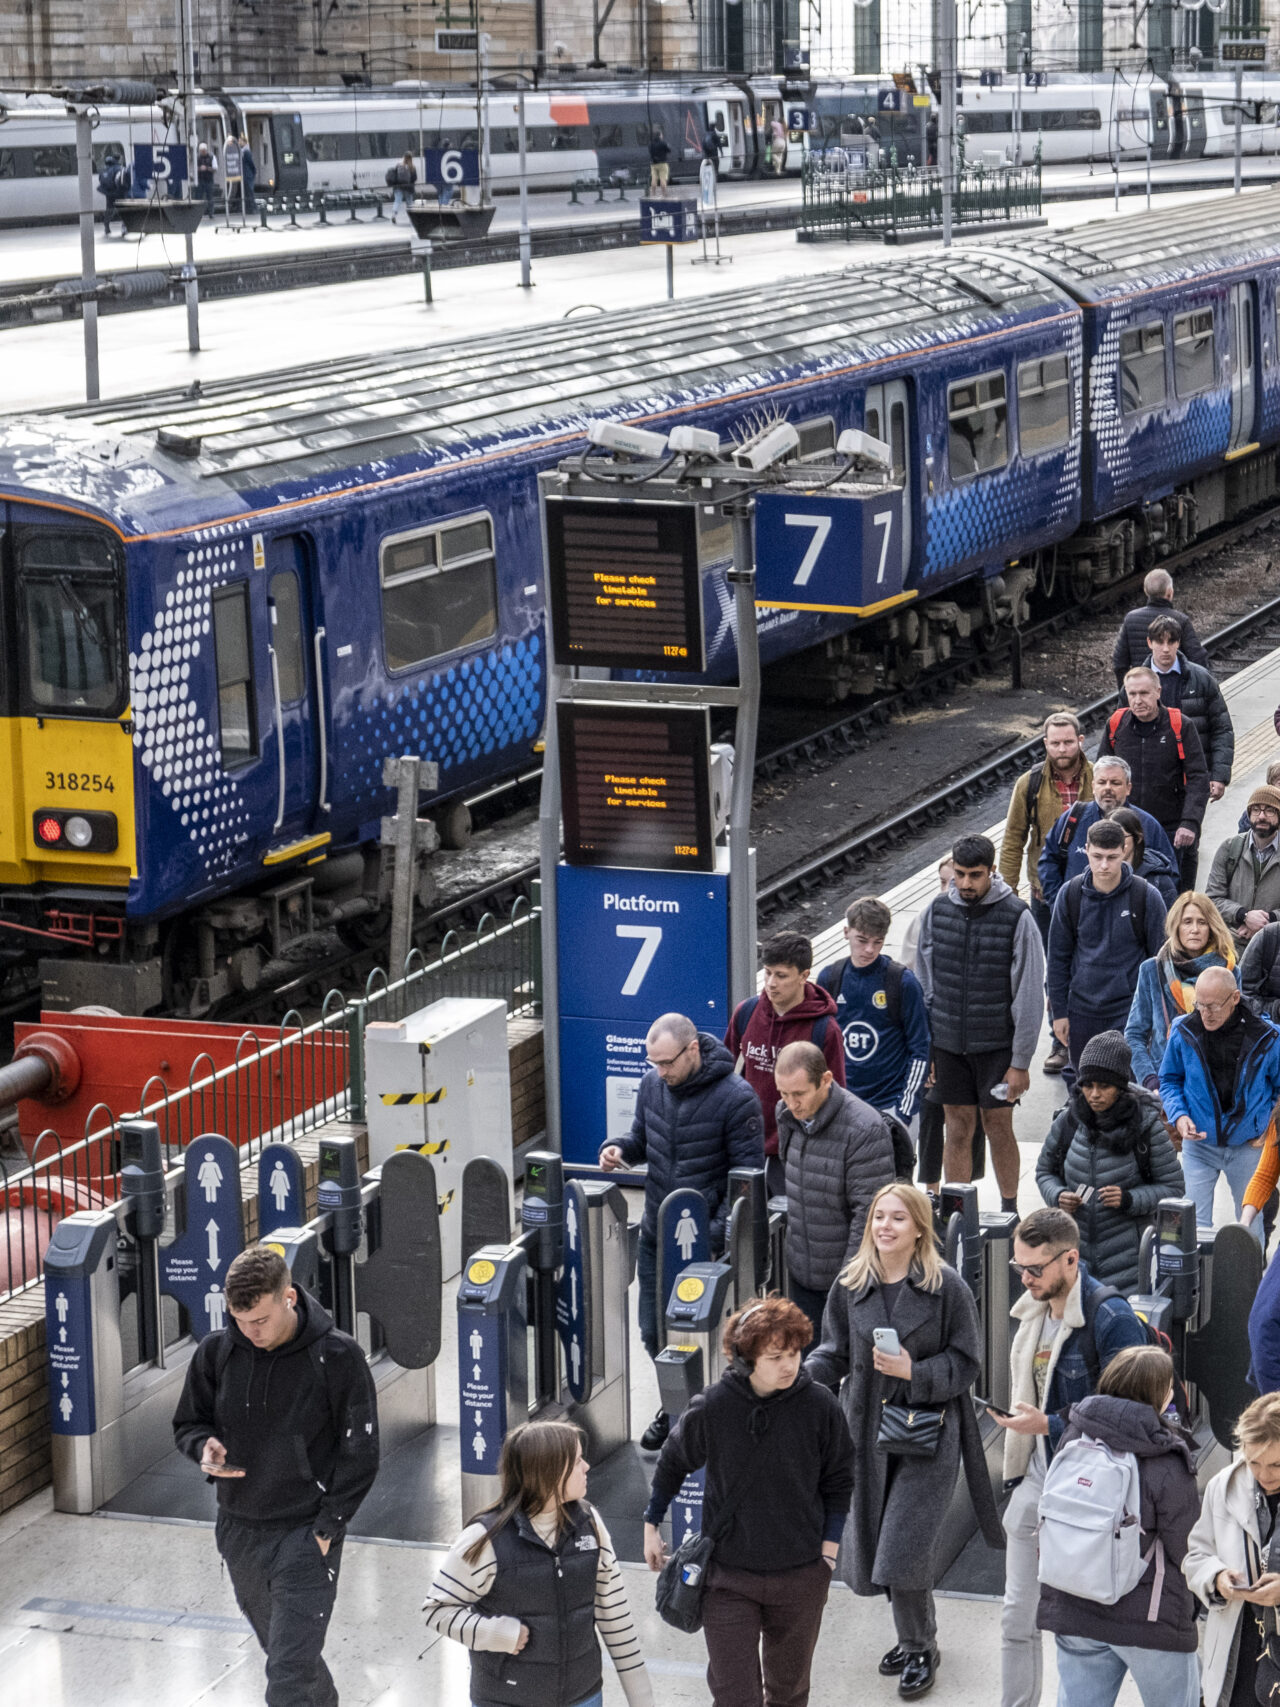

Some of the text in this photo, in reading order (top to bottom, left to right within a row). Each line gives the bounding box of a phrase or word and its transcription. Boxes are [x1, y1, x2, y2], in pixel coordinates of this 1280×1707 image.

[1029, 72, 1036, 84] 2
[883, 92, 895, 109] 4
[793, 110, 805, 129] 3
[152, 145, 172, 179] 5
[440, 150, 464, 183] 6
[784, 512, 832, 586] 7
[873, 510, 892, 584] 7
[593, 573, 656, 585] Please check
[603, 585, 648, 596] timetable
[596, 596, 656, 608] for services
[45, 770, 115, 793] 318254
[604, 775, 667, 786] Please check
[614, 786, 658, 797] timetable
[606, 797, 667, 808] for services
[603, 893, 680, 914] Platform
[615, 924, 662, 996] 7
[848, 1032, 871, 1050] BT
[605, 1043, 642, 1054] Central
[746, 1041, 768, 1057] Jack
[171, 1258, 194, 1266] Please
[166, 1266, 199, 1275] keep your
[168, 1274, 198, 1282] distance
[53, 1344, 75, 1353] Please
[50, 1352, 80, 1362] keep your
[51, 1360, 79, 1370] distance
[466, 1382, 489, 1391] Please
[462, 1391, 478, 1400] keep
[464, 1399, 493, 1408] distance
[675, 1496, 703, 1504] distance
